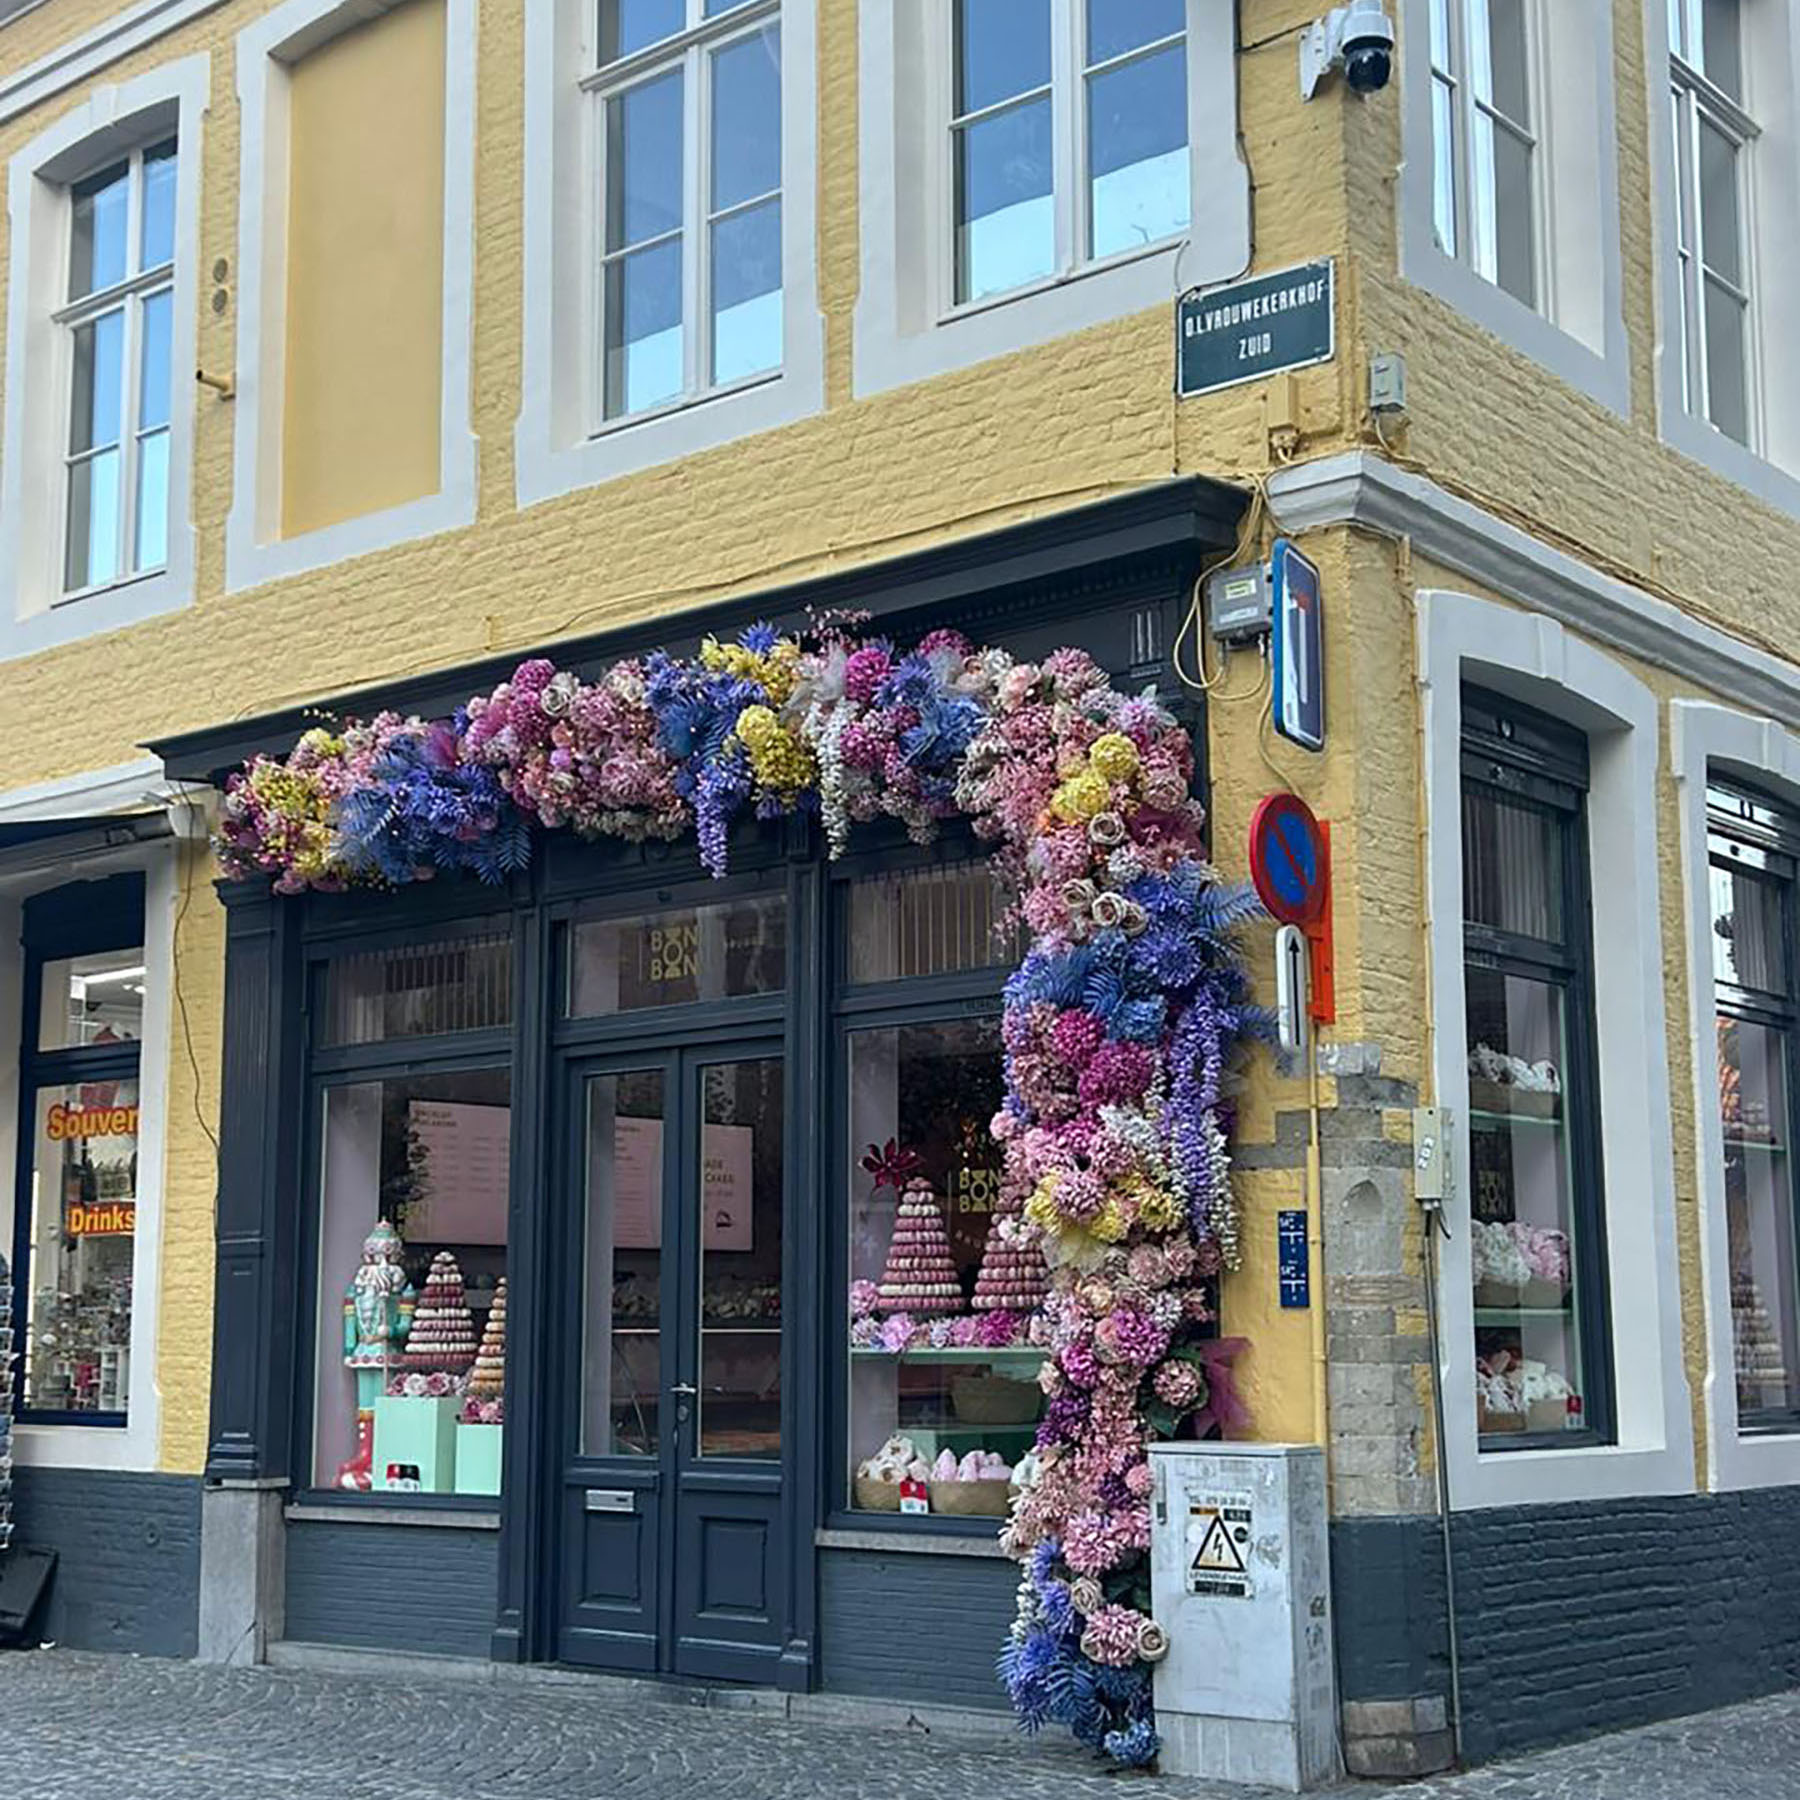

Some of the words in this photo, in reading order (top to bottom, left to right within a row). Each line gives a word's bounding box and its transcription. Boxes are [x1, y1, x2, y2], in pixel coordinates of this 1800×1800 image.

[1239, 333, 1271, 360] ZUID
[47, 1104, 137, 1140] Souver
[69, 1204, 135, 1235] Drinks
